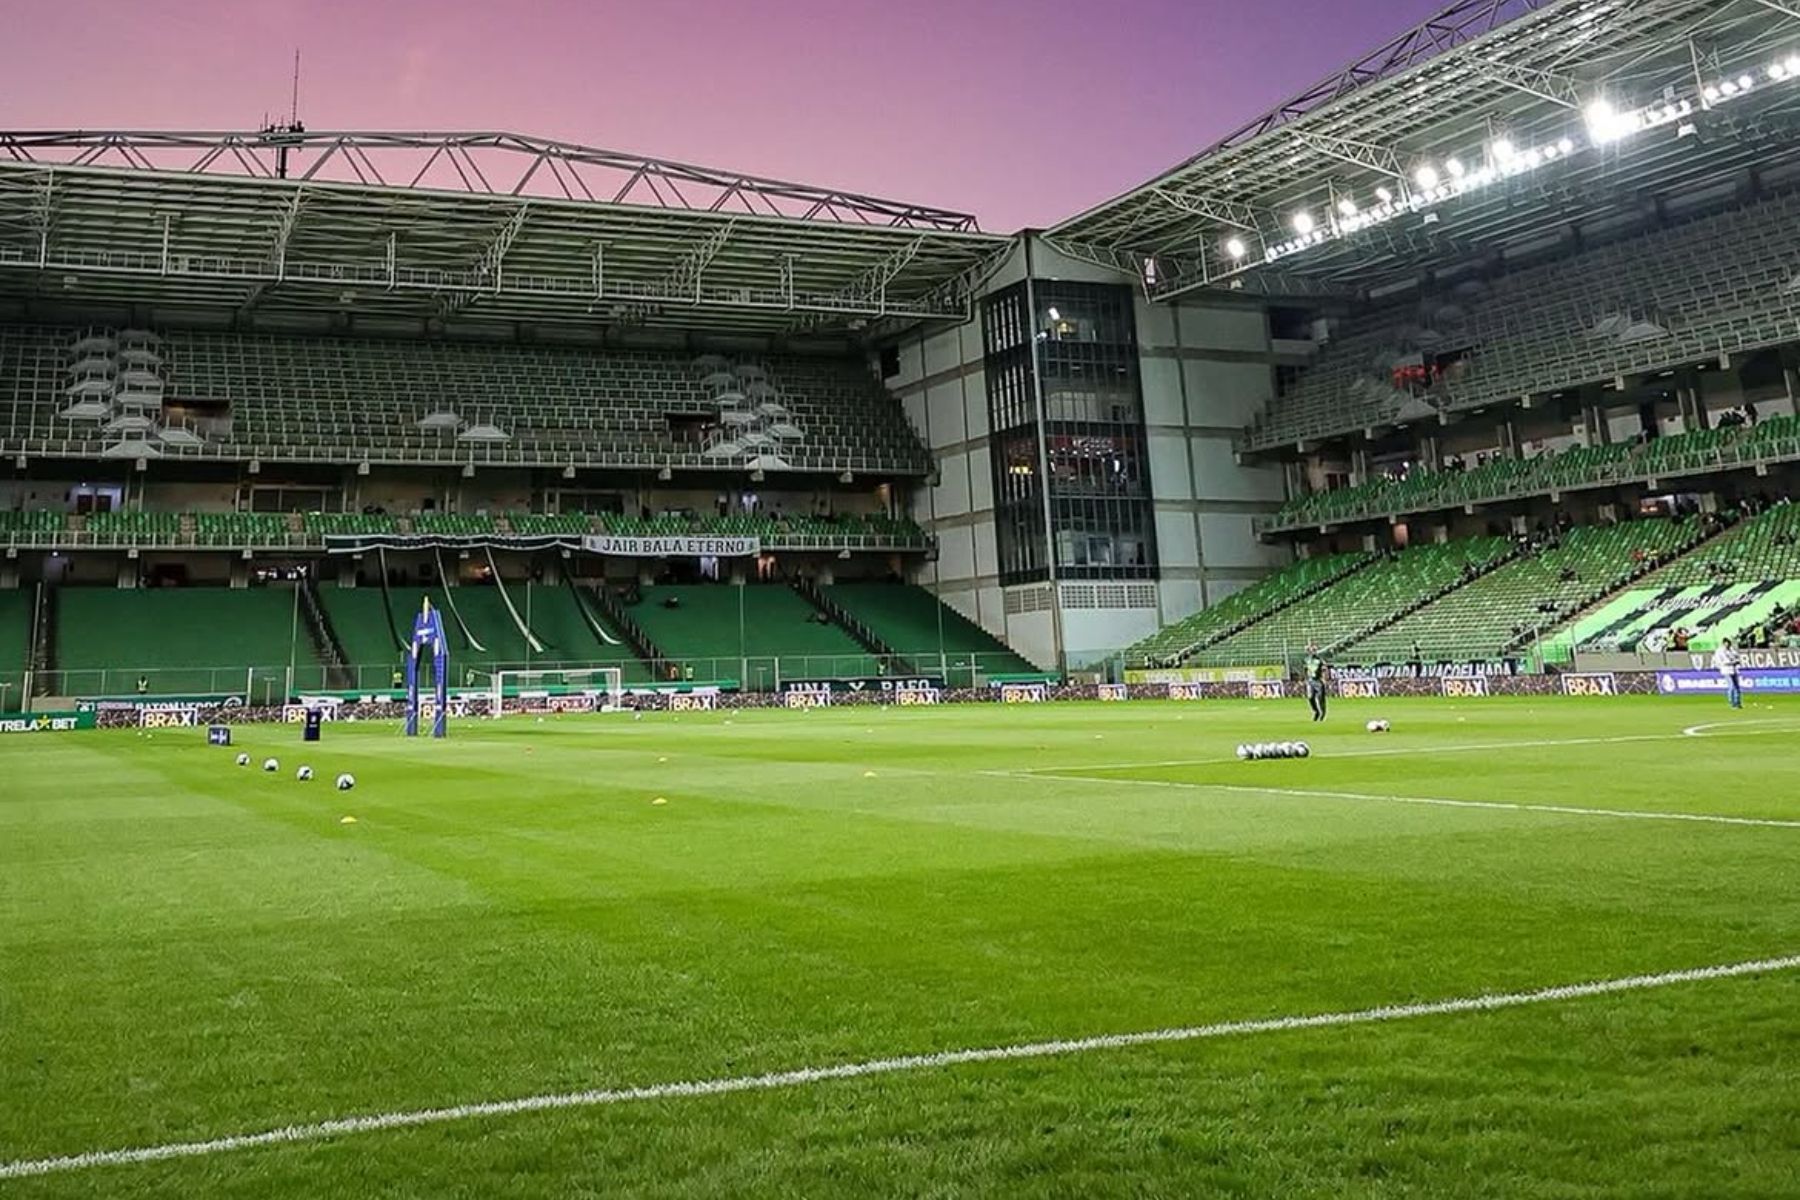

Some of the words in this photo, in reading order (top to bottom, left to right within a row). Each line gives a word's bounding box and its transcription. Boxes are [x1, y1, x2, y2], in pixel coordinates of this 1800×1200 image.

[603, 540, 637, 551] JAIR
[643, 540, 682, 552] BALA
[687, 540, 744, 553] ETERNO
[1420, 662, 1511, 679] AVACOELHADA
[1101, 687, 1124, 700] BRAX
[1172, 686, 1198, 699] BRAX
[1251, 684, 1281, 698] BRAX
[1343, 681, 1376, 696] BRAX
[1447, 680, 1484, 696] BRAX
[1567, 679, 1612, 696] BRAX
[673, 696, 712, 711] BRAX
[789, 693, 826, 708] BRAX
[900, 691, 935, 705] BRAX
[1006, 689, 1041, 703] BRAX
[146, 712, 191, 727] BRAX
[288, 708, 332, 723] BRX
[52, 718, 77, 730] BET
